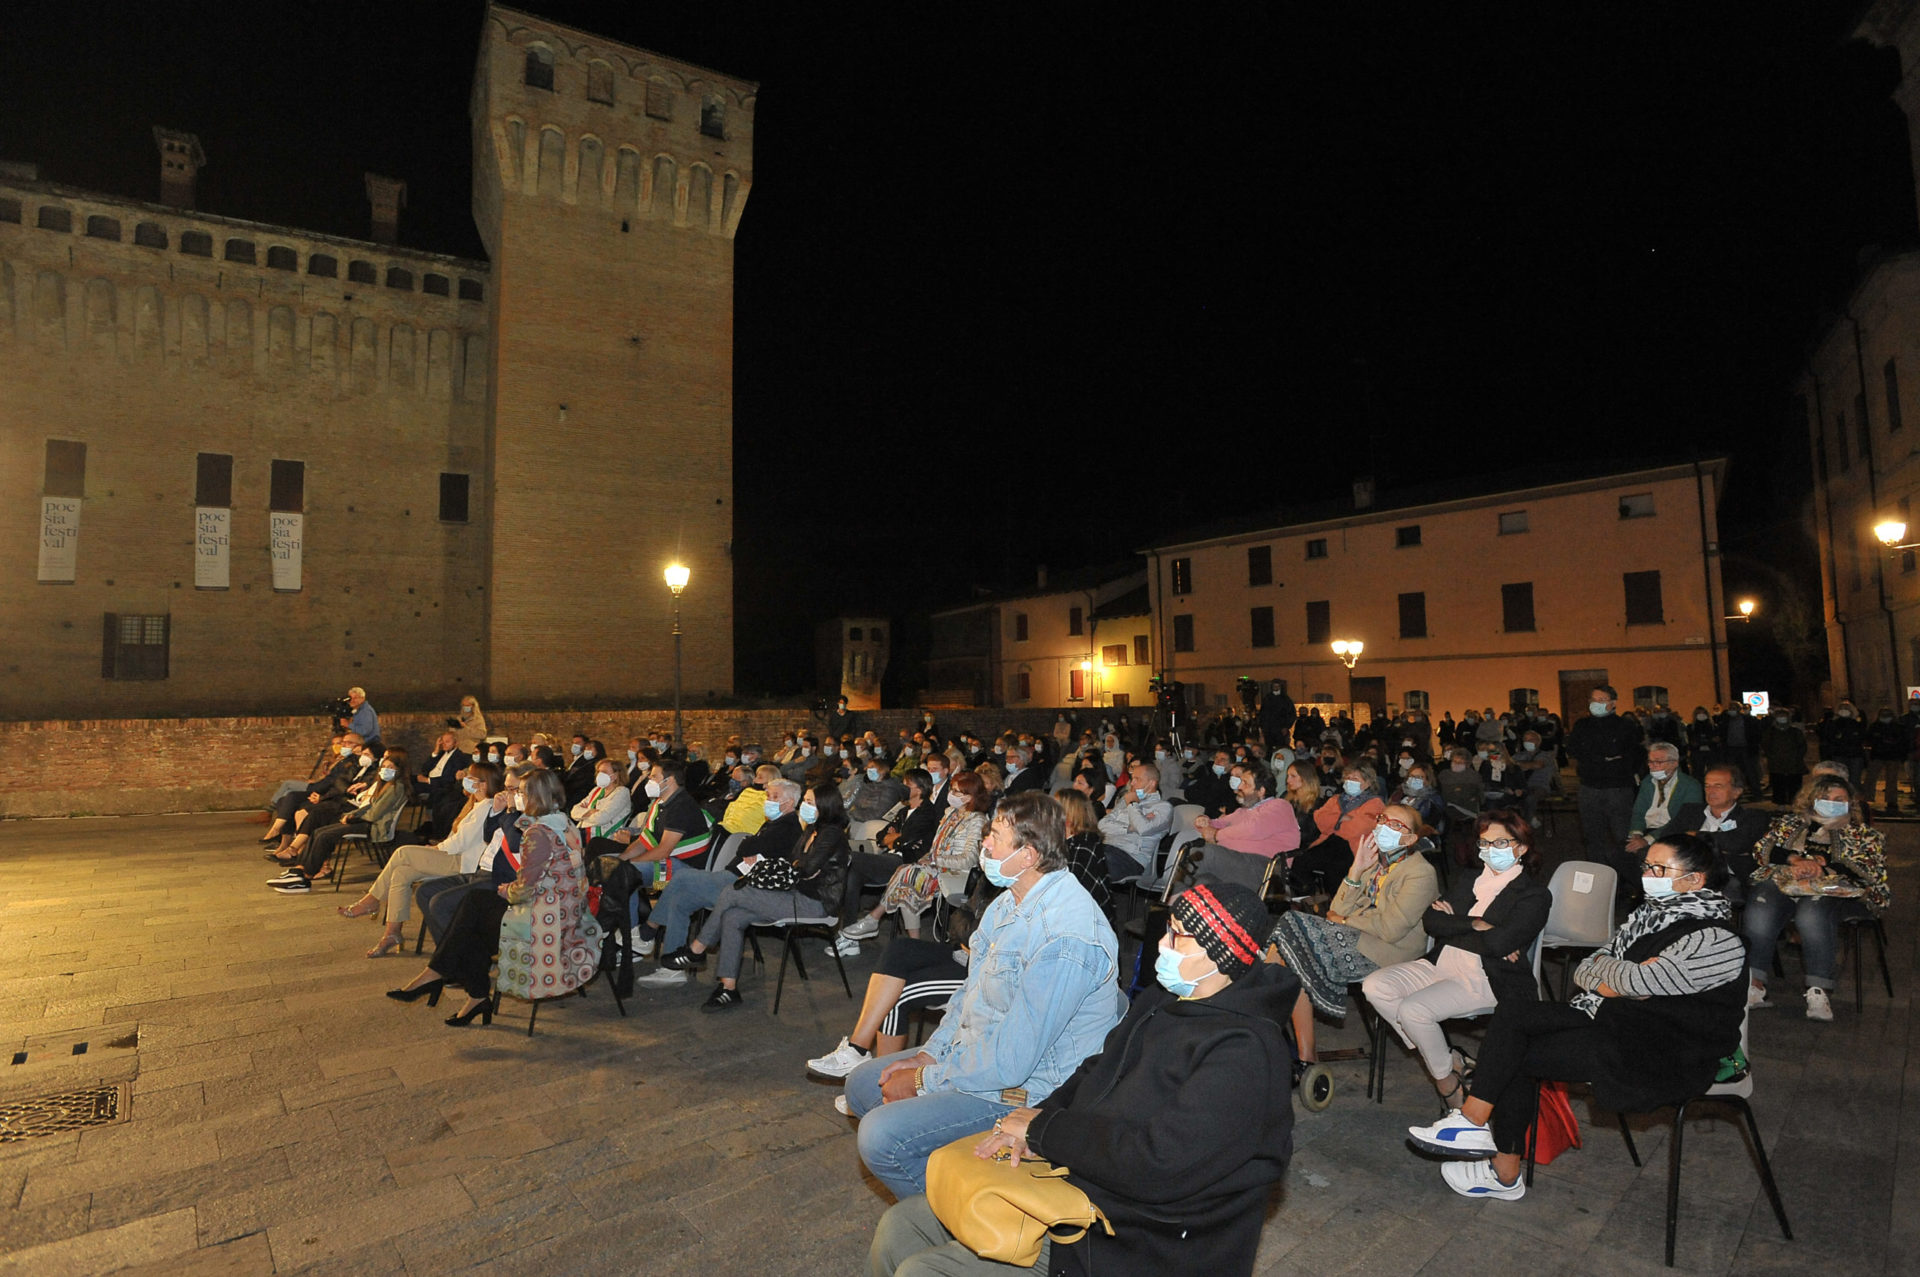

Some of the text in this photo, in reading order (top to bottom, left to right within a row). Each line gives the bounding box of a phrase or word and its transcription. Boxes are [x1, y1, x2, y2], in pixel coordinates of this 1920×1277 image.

[44, 512, 66, 524] sia
[44, 524, 78, 537] festi
[198, 522, 217, 533] sia
[272, 526, 291, 537] sia
[43, 536, 65, 548] val
[198, 533, 229, 545] festi
[272, 537, 300, 549] festi
[198, 544, 217, 556] val
[271, 549, 290, 559] val
